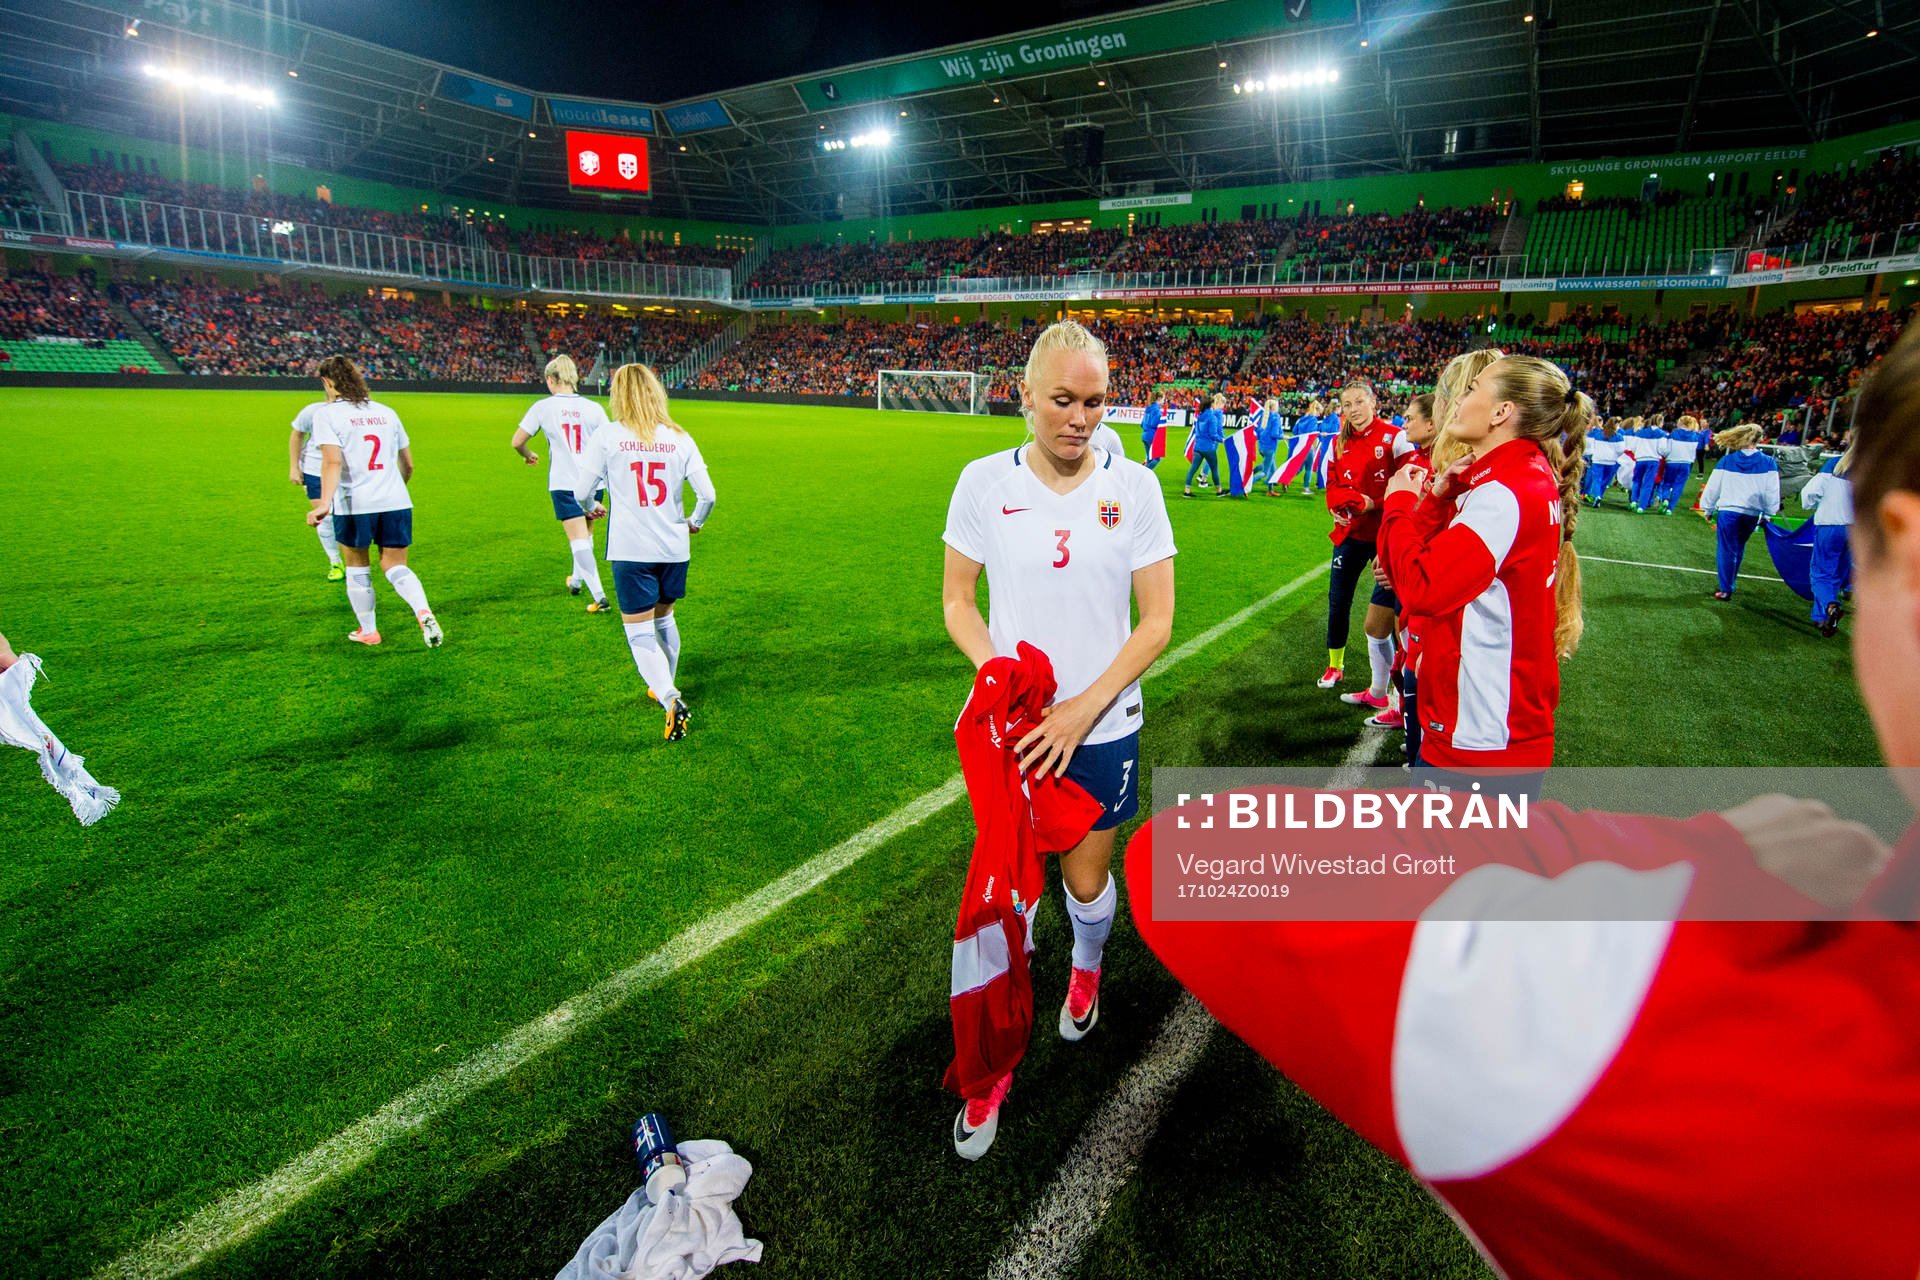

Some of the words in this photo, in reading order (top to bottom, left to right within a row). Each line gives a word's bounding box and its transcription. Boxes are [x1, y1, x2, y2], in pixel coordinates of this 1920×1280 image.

[940, 57, 975, 79] Wij
[979, 51, 1015, 74] zijn
[1019, 32, 1127, 64] Groningen
[553, 107, 650, 128] noordlease
[1551, 161, 1620, 175] SKYLOUNGE
[1624, 156, 1701, 171] GRONINGEN
[1704, 152, 1761, 165] AIRPORT
[1765, 149, 1807, 161] EELDE
[1111, 199, 1142, 208] KOEMAN
[1145, 196, 1178, 205] TRIBUNE
[1729, 272, 1783, 283] topcleaning
[1830, 261, 1880, 274] FieldTurf
[1501, 279, 1554, 290] topcleaning
[1559, 276, 1725, 289] www.wassenenstomen.nl
[561, 423, 581, 454] 11
[364, 434, 384, 471] 2
[630, 461, 667, 508] 15
[1053, 529, 1071, 569] 3
[1119, 760, 1134, 796] 3
